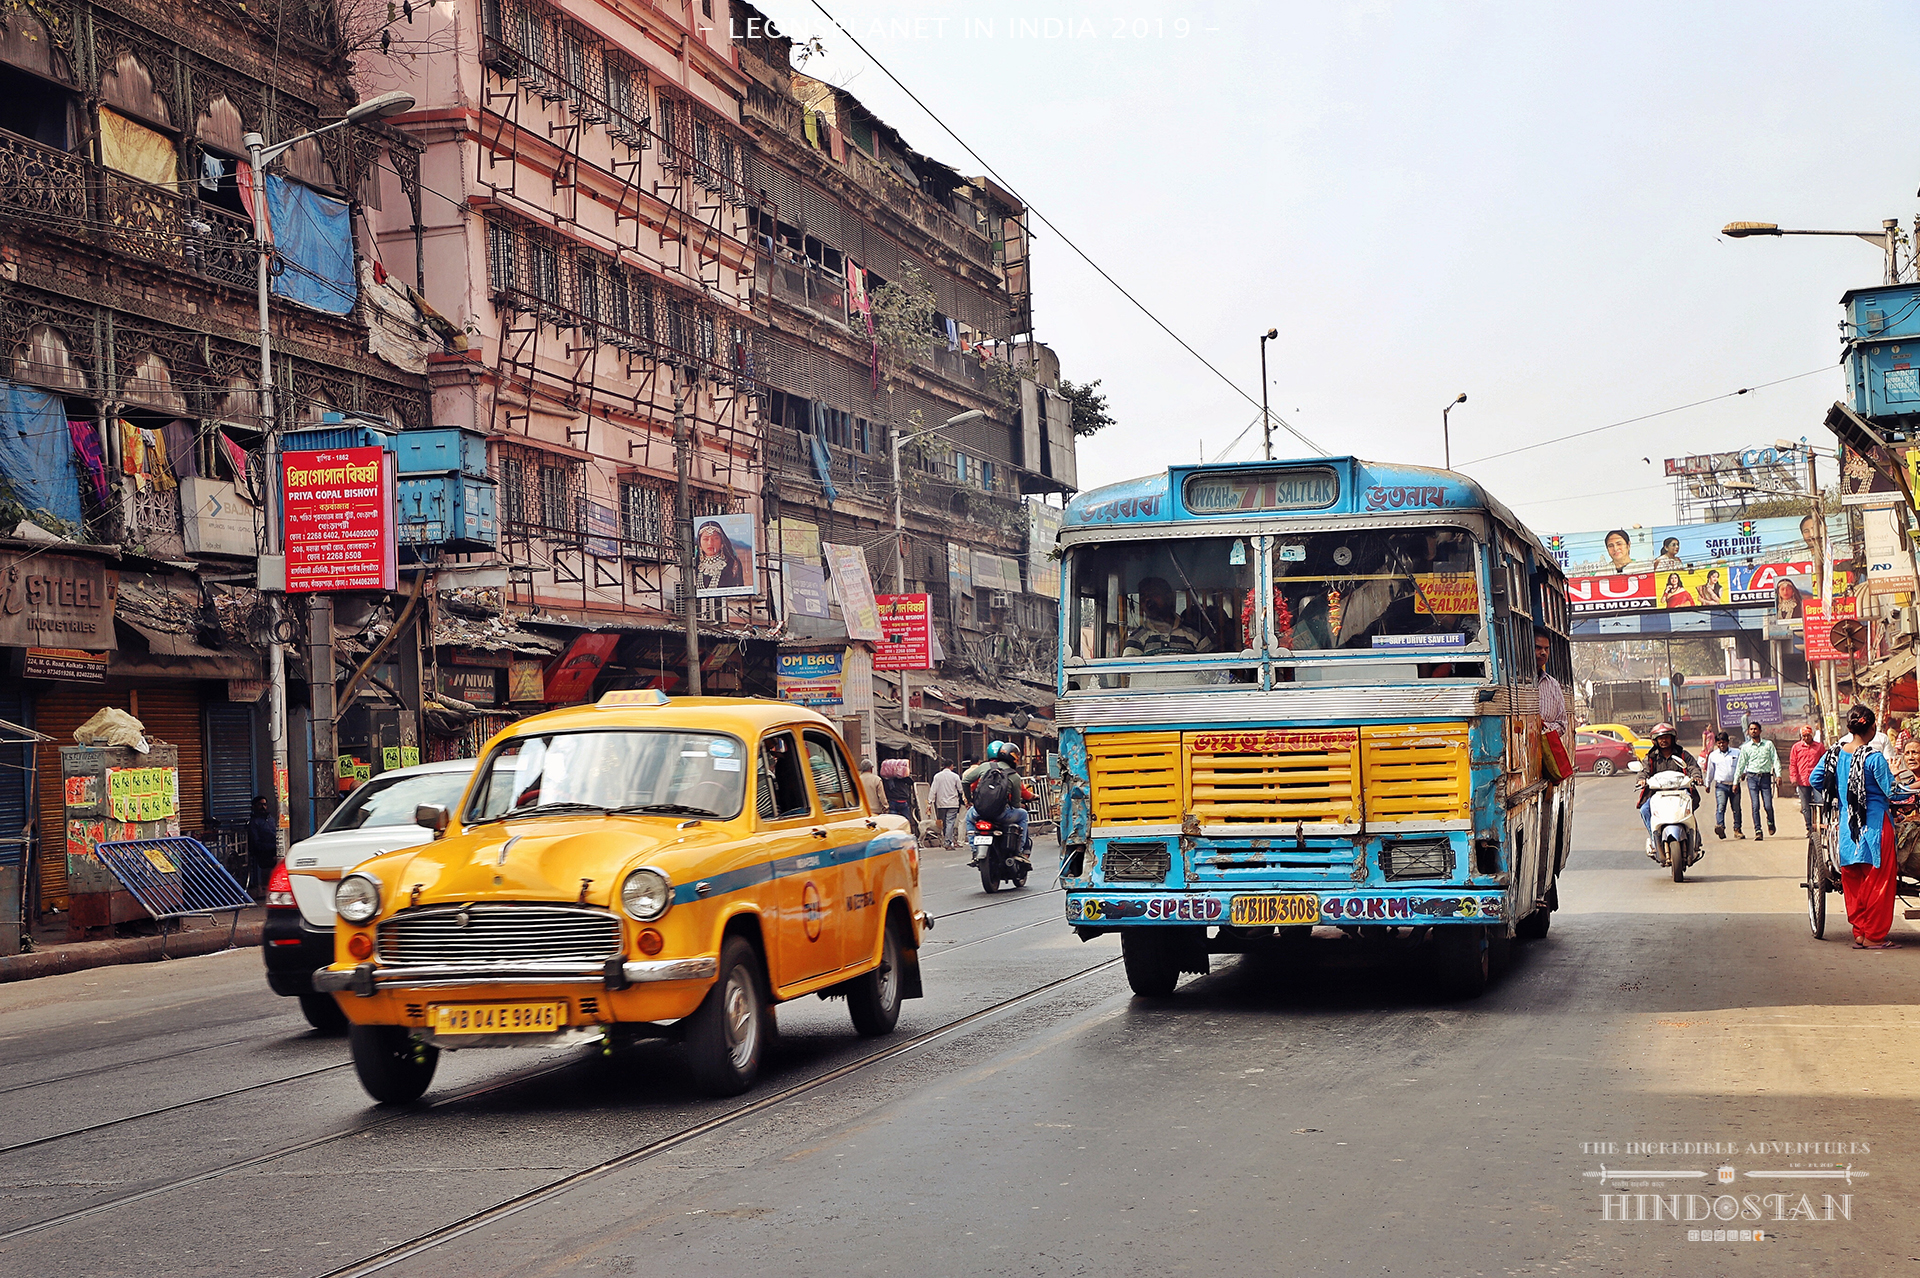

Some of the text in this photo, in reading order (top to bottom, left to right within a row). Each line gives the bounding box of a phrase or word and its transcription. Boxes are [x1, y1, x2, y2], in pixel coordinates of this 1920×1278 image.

[1664, 451, 1740, 476] LUX
[287, 461, 378, 487] প্রিয় গোপাল বিষয়ী
[288, 486, 378, 501] PRIYA GOPAL BISHOYI
[1190, 486, 1229, 509] OWRAH
[1232, 477, 1277, 509] 71
[223, 501, 254, 518] BAJA
[307, 532, 322, 540] 2268
[341, 529, 379, 538] 7044092000
[1705, 536, 1762, 548] SAFE DRIVE
[326, 552, 343, 560] 2268
[344, 551, 362, 559] 6508
[1711, 545, 1762, 557] SAVE LIFE
[26, 574, 101, 608] STEEL
[1416, 597, 1479, 612] SEALDAH
[1574, 600, 1652, 612] BERMUDA
[27, 618, 97, 634] INDUSTRIES
[1389, 635, 1460, 645] SAFE DRIVE SAVE LIFE
[782, 654, 835, 666] OM BAG
[466, 674, 494, 688] NIVIA
[610, 693, 650, 703] TAXI
[1148, 897, 1223, 920] SPEED
[474, 1009, 494, 1029] 04
[500, 1008, 508, 1028] E
[513, 1007, 554, 1027] 9846
